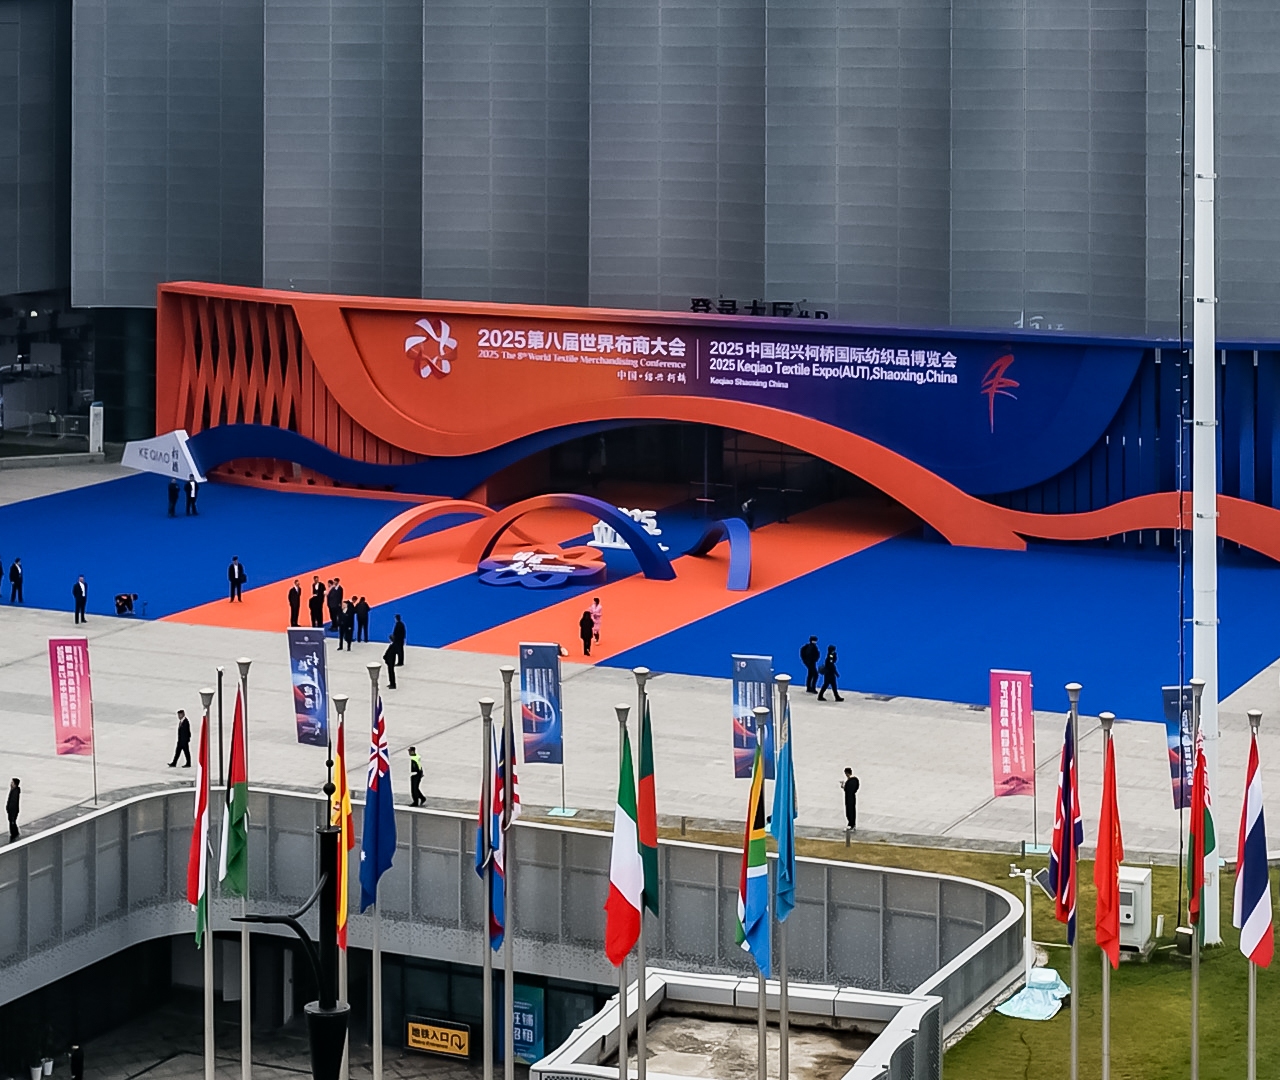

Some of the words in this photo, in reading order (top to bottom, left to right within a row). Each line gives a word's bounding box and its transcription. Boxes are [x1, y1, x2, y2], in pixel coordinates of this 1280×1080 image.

[478, 349, 499, 359] 2025
[501, 351, 516, 360] The
[527, 352, 551, 362] World
[553, 353, 579, 363] Textile
[580, 355, 639, 368] Merchandising
[640, 358, 687, 369] Conference
[709, 341, 744, 356] 2025
[746, 341, 958, 369] 中国绍兴柯桥国际纺织品博览会
[709, 358, 735, 371] 2025
[737, 360, 773, 375] Keqiao
[775, 361, 811, 375] Textile
[769, 379, 789, 389] China
